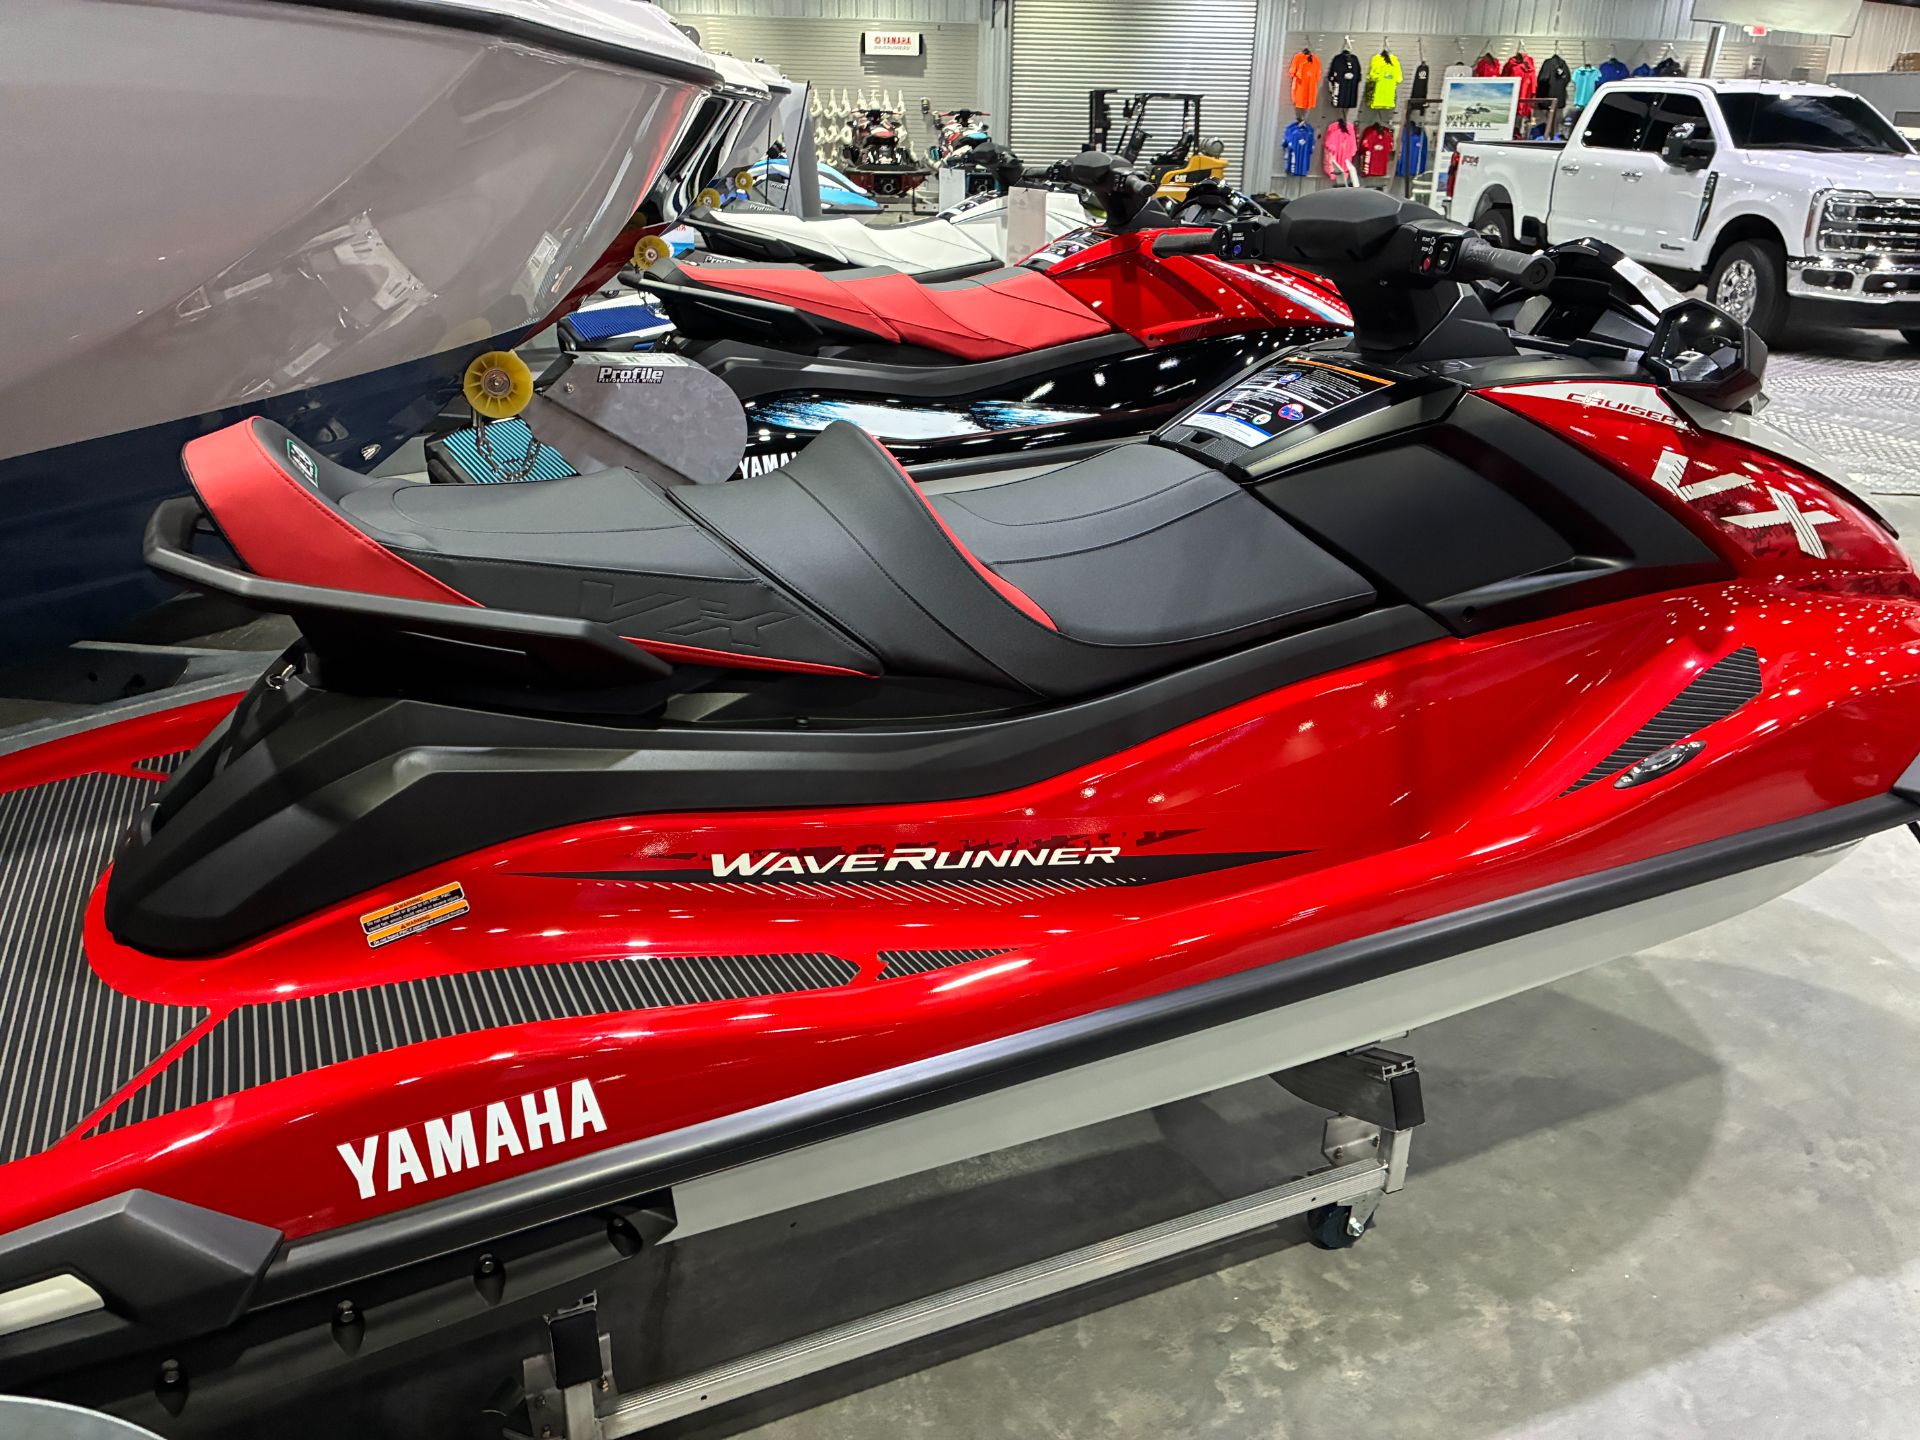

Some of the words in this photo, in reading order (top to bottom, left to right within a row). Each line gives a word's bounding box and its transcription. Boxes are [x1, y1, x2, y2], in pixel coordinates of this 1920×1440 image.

[598, 367, 664, 379] Profile
[1567, 393, 1678, 424] CRUISER
[1651, 449, 1841, 560] VX
[336, 1078, 608, 1200] YAMAHA
